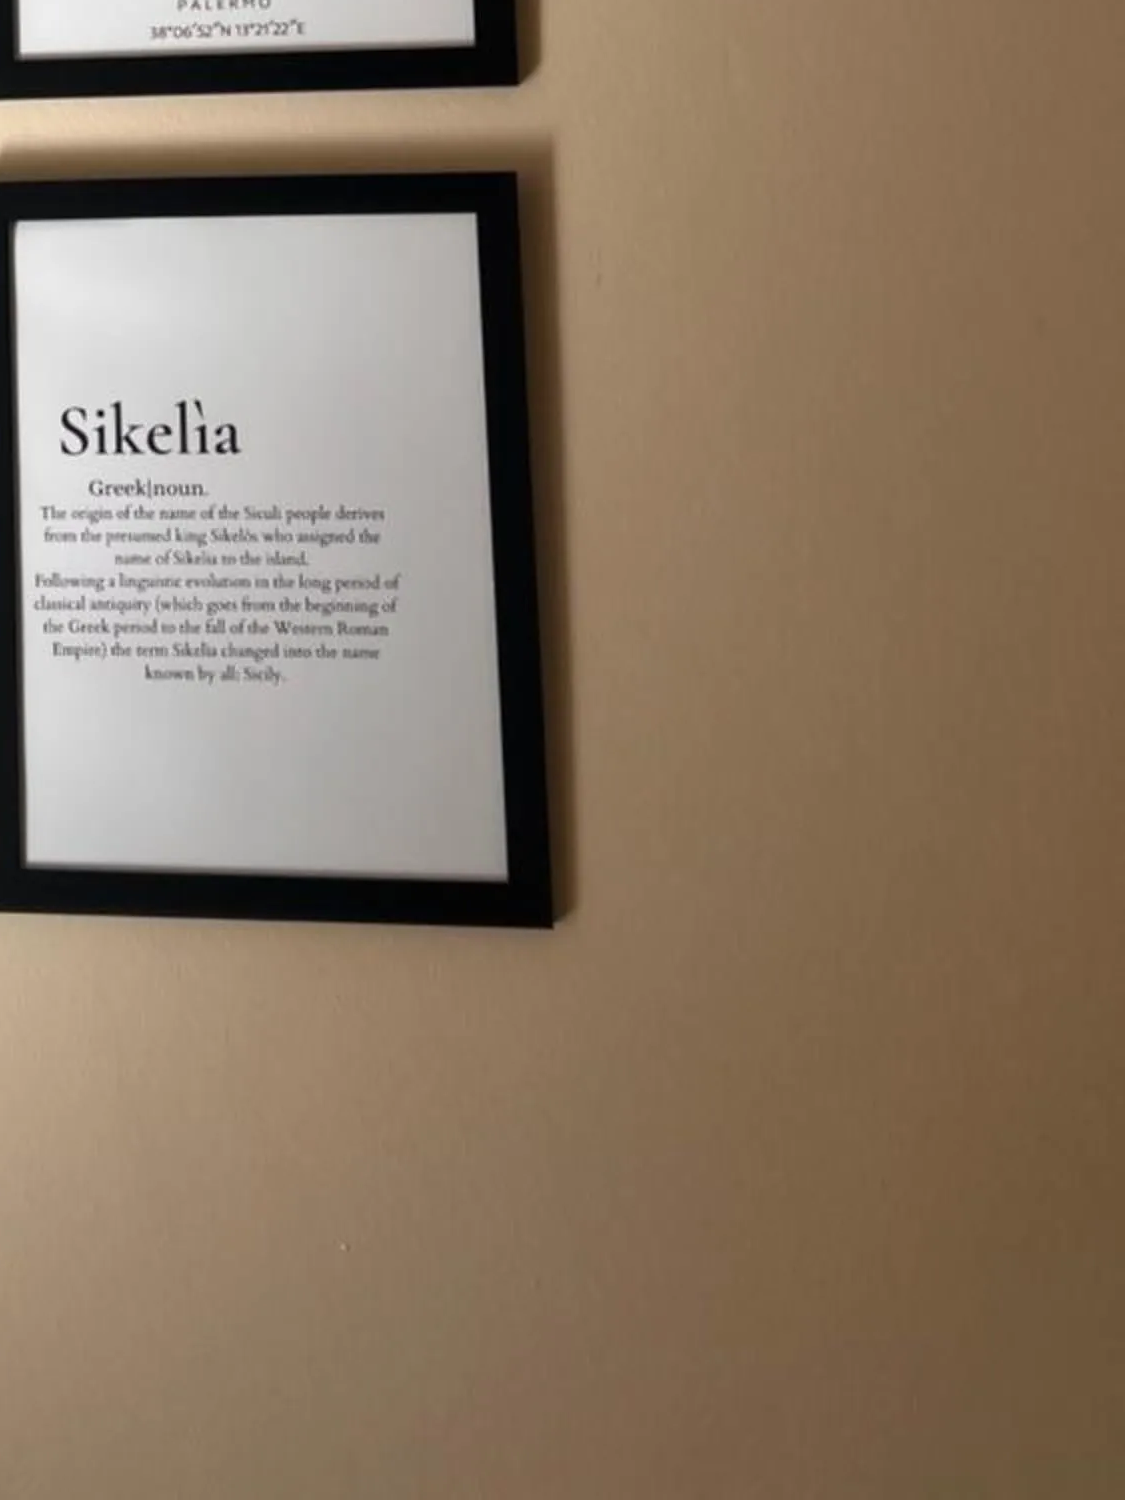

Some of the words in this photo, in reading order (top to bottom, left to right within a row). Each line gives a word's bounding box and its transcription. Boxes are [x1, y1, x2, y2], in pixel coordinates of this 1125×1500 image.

[60, 398, 242, 456] Sikelìa
[41, 505, 66, 520] The
[71, 506, 113, 524] origin
[116, 504, 132, 520] of
[134, 505, 155, 520] the
[159, 508, 195, 520] name
[200, 504, 216, 520] of
[218, 505, 239, 520] the
[244, 505, 281, 520] Siculi
[285, 505, 331, 525] people
[335, 505, 385, 521] derives
[44, 527, 77, 542] from
[81, 527, 102, 542] the
[106, 527, 171, 547] presumed
[175, 527, 208, 547] king
[262, 528, 293, 543] who
[297, 528, 355, 547] assigned
[359, 528, 380, 543] the
[115, 553, 151, 565] name
[155, 549, 172, 565] of
[221, 553, 236, 565] to
[240, 551, 261, 565] the
[267, 551, 309, 566] island.
[35, 572, 105, 592] Following
[108, 577, 115, 587] a
[119, 572, 181, 592] linguistic
[185, 572, 251, 588] evolution
[255, 576, 269, 588] in
[273, 573, 294, 588] the
[298, 573, 332, 593] long
[335, 573, 380, 594] period
[384, 573, 401, 589] of
[33, 595, 85, 611] classical
[90, 596, 151, 615] antiquity
[155, 595, 203, 612] (which
[206, 600, 237, 615] goes
[241, 595, 275, 612] from
[279, 596, 300, 612] the
[305, 596, 379, 617] beginning
[381, 596, 398, 613] of
[43, 618, 63, 633] the
[68, 618, 110, 634] Greek
[113, 618, 157, 638] period
[161, 622, 176, 634] to
[179, 619, 200, 634] the
[205, 618, 226, 634] fall
[229, 618, 246, 634] of
[248, 619, 269, 635] the
[273, 620, 333, 636] Western
[337, 620, 389, 636] Roman
[52, 641, 107, 660] Empire)
[111, 642, 132, 657] the
[136, 645, 168, 657] term
[221, 643, 279, 662] changed
[283, 645, 312, 659] into
[315, 644, 337, 659] the
[342, 648, 379, 660] name
[144, 664, 194, 680] known
[198, 665, 216, 685] by
[243, 665, 286, 686] Sicily.
